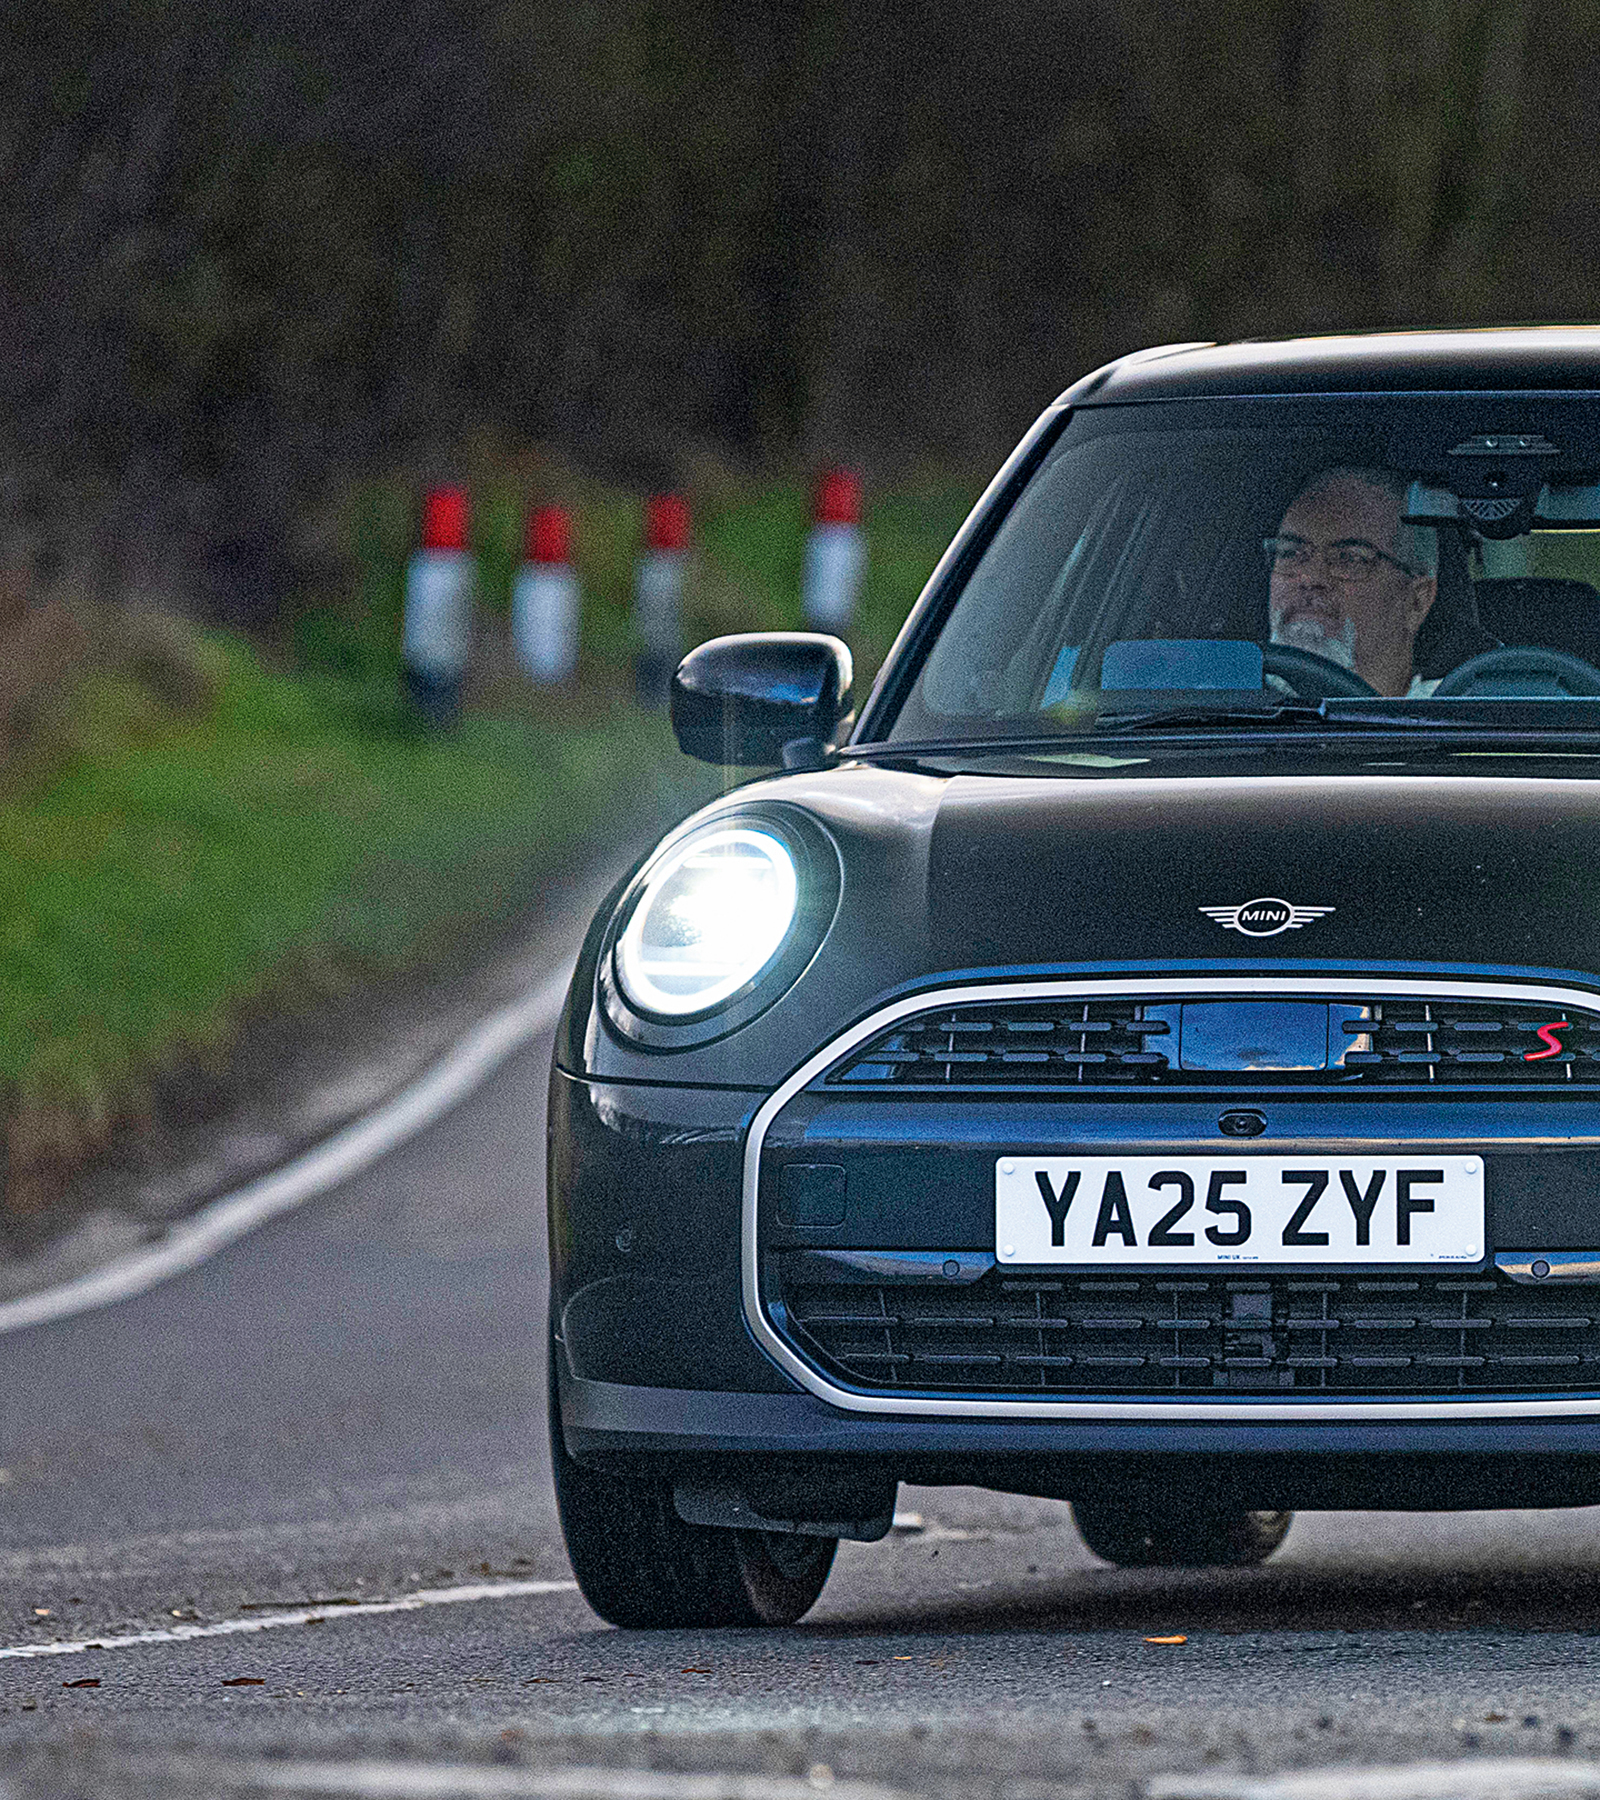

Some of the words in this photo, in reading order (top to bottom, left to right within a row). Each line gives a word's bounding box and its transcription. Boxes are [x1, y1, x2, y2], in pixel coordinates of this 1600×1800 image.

[1241, 910, 1287, 921] MINI
[1523, 1021, 1569, 1061] S
[1034, 1170, 1252, 1248] YA25
[1281, 1169, 1445, 1247] ZYF
